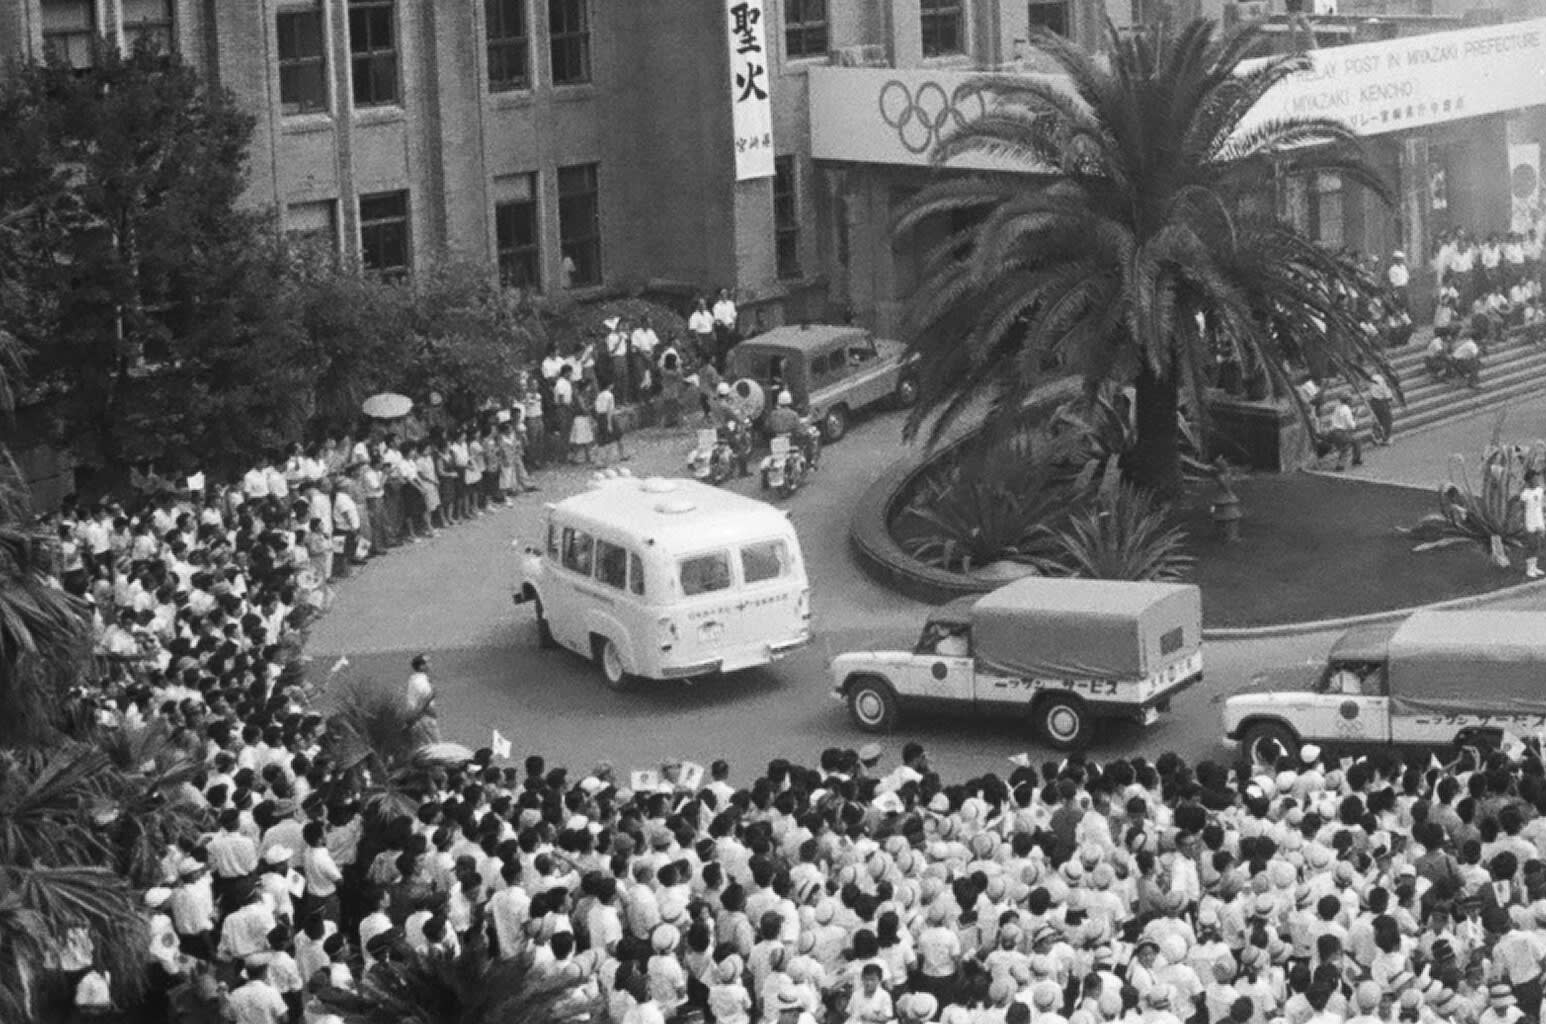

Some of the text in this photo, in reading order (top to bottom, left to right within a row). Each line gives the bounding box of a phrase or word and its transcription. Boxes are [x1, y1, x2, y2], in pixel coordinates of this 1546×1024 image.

[1345, 54, 1379, 74] POST
[1388, 53, 1401, 68] IN
[1407, 44, 1458, 67] MIYAZAKI
[1464, 31, 1542, 58] PREFECTURE
